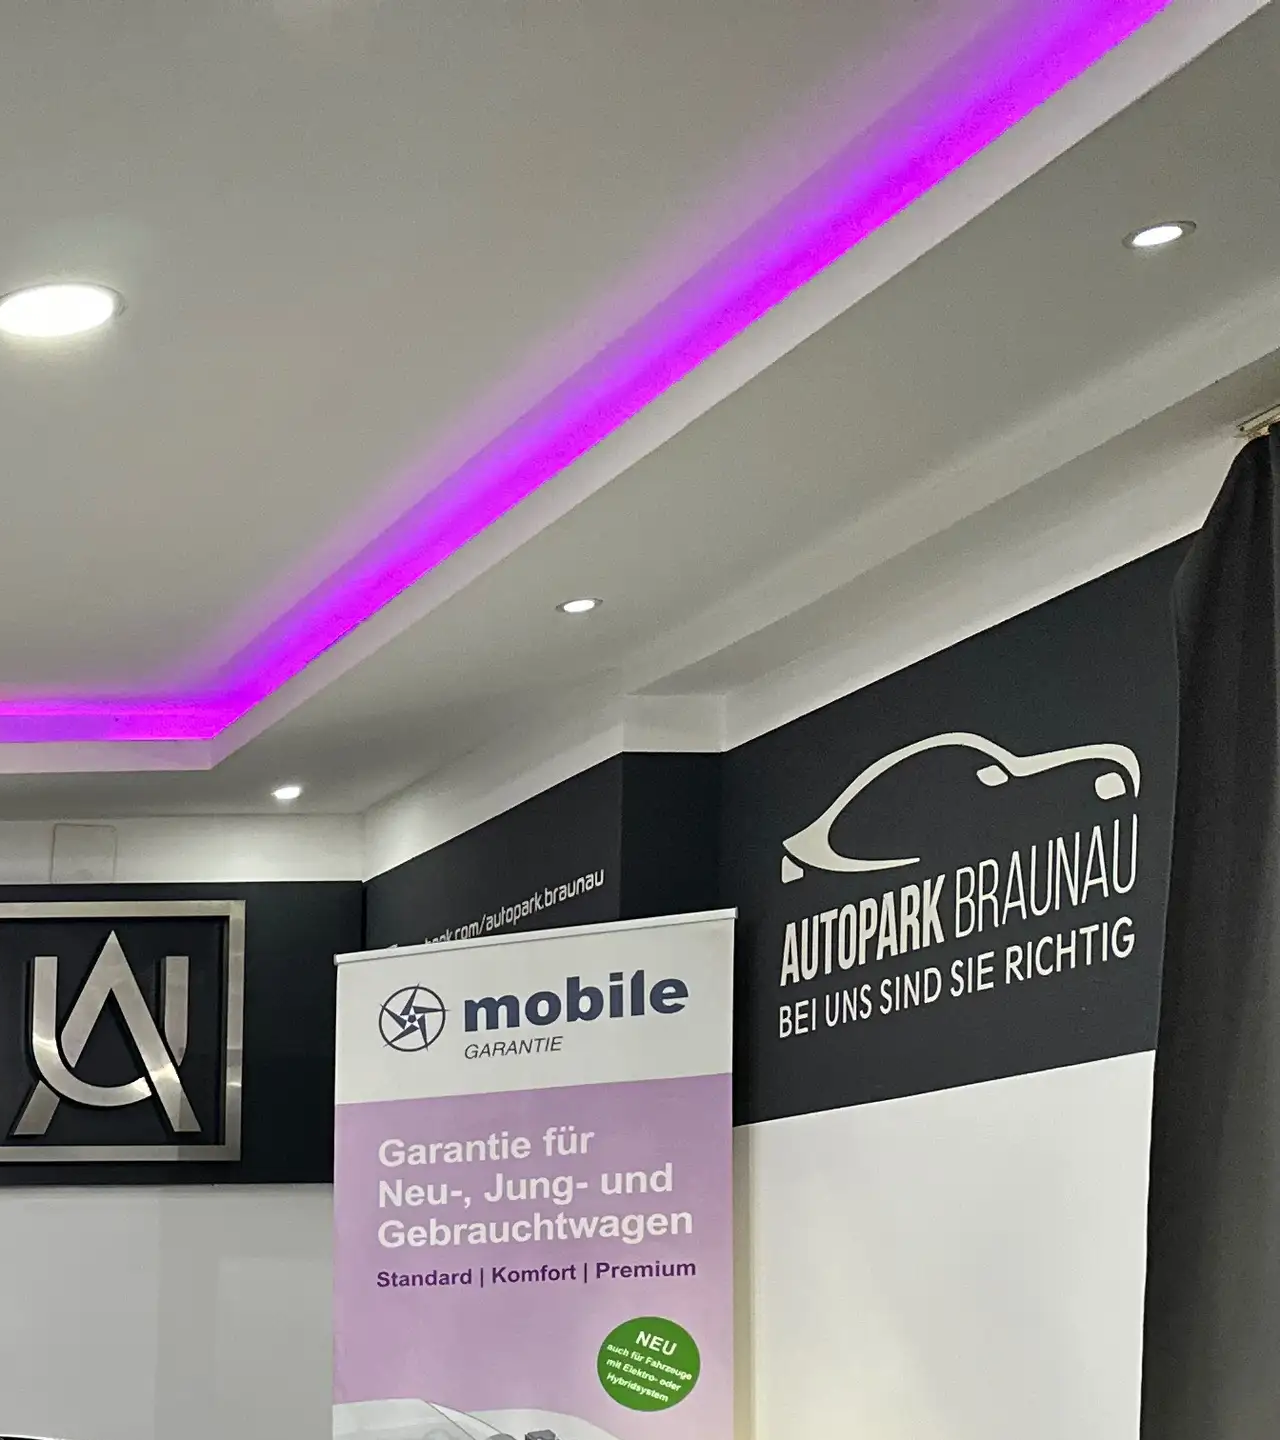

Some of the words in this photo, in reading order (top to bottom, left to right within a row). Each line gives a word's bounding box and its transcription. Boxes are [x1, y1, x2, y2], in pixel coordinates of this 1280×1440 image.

[779, 873, 946, 987] AUTOPARK
[955, 813, 1138, 939] BRAUNAU
[779, 997, 817, 1039] BEI
[825, 983, 873, 1027] UNS
[879, 967, 942, 1015] SIND
[950, 950, 995, 997] SIE
[1005, 916, 1135, 985] RICHTIG
[464, 969, 689, 1033] mobile
[464, 1035, 564, 1060] GARANTIE
[378, 1132, 531, 1167] Garantie
[543, 1126, 595, 1156] für
[379, 1180, 471, 1209] Neu-,
[484, 1174, 588, 1206] Jung-
[601, 1163, 673, 1195] und
[377, 1211, 693, 1248] Gebrauchtwagen
[377, 1268, 472, 1288] Standard
[492, 1264, 577, 1284] Komfort
[596, 1261, 696, 1279] Premium
[635, 1330, 678, 1356] NEU
[606, 1358, 622, 1370] mit
[659, 1379, 682, 1392] oder
[607, 1344, 629, 1357] auch
[630, 1351, 645, 1363] für
[645, 1356, 693, 1380] Fahrzeuge
[606, 1372, 669, 1402] Hybridsystem
